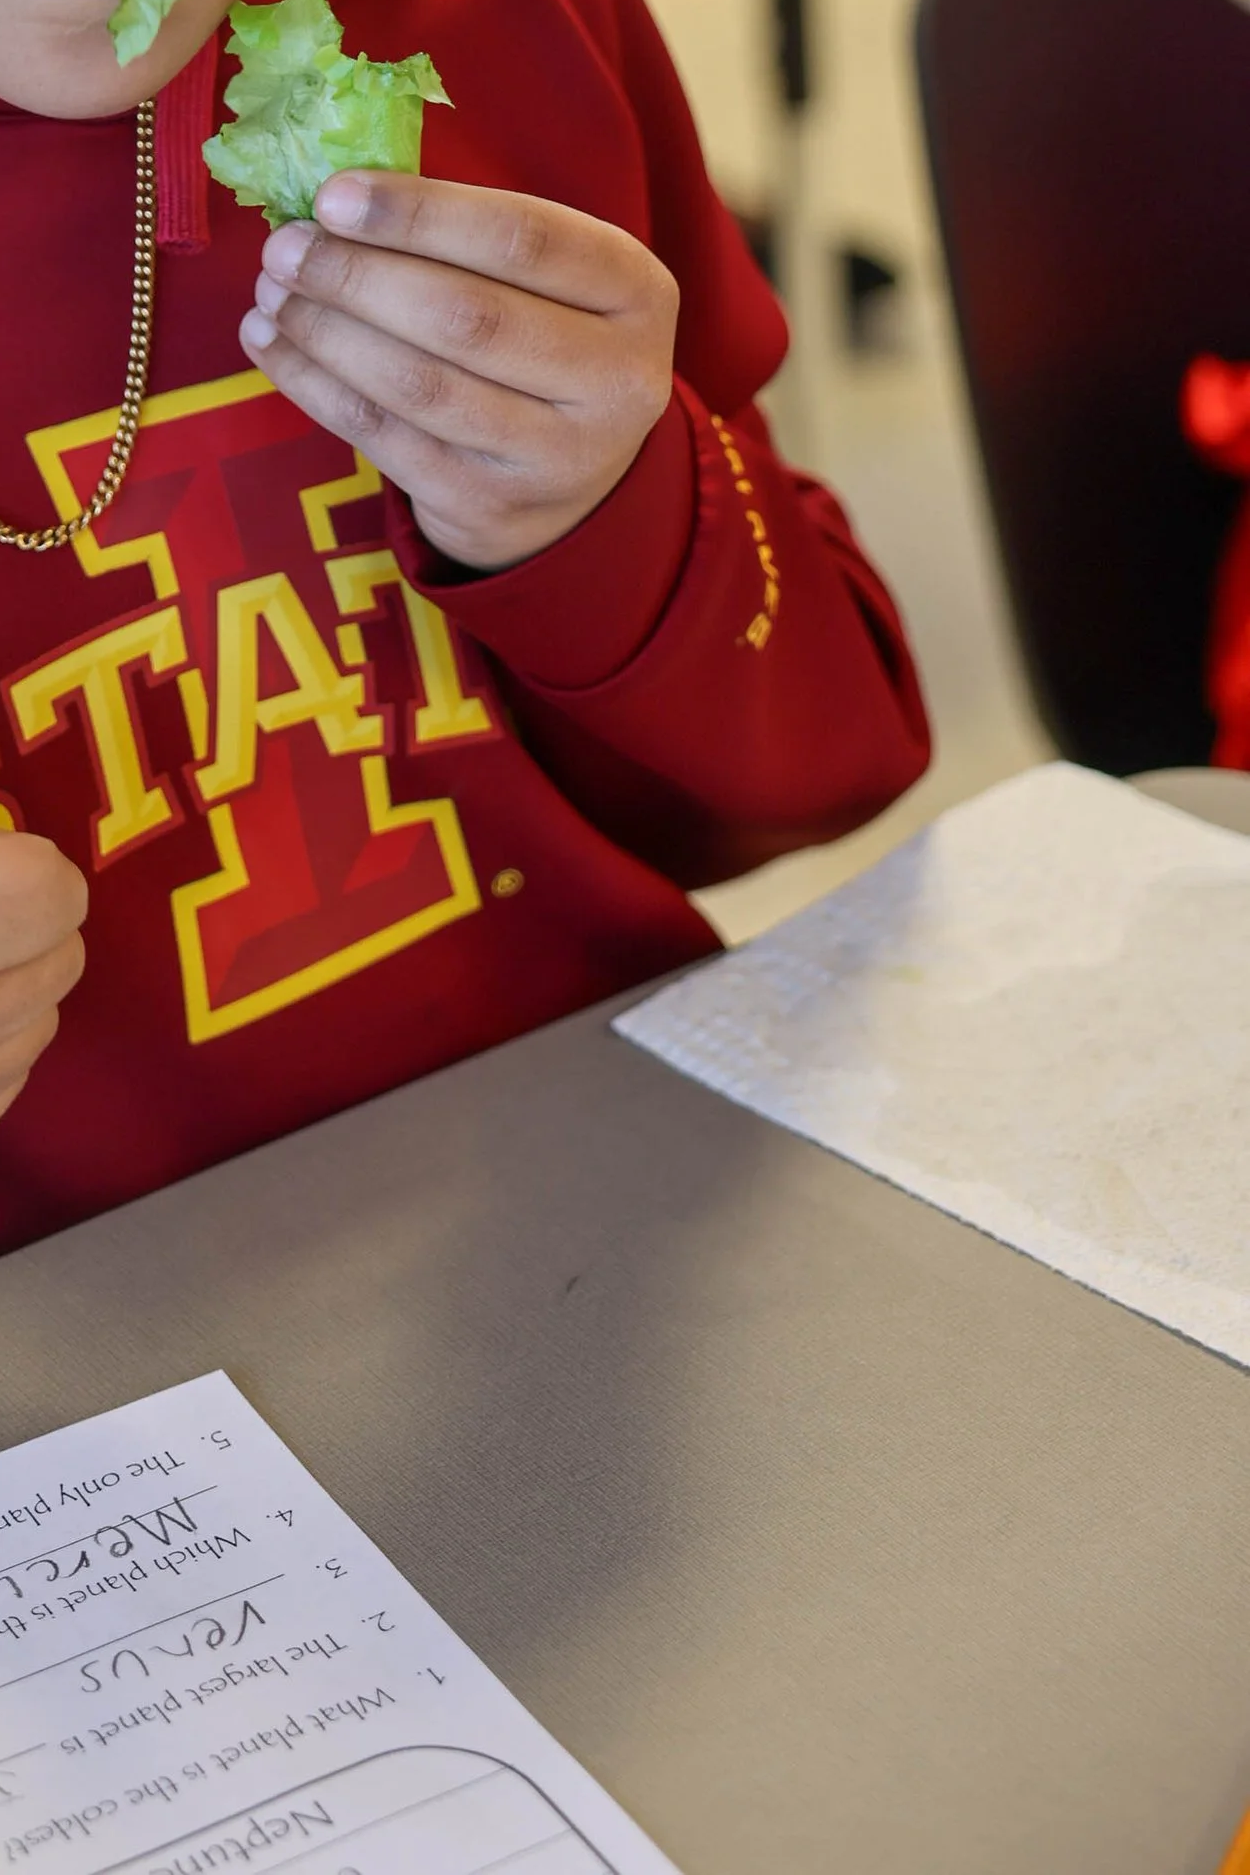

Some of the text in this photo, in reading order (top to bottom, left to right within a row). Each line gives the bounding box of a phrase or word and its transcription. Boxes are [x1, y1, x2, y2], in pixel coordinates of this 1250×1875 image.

[200, 1429, 233, 1451] 5.
[125, 1450, 186, 1478] The
[59, 1471, 121, 1508] only
[265, 1509, 294, 1528] 4.
[152, 1527, 252, 1576] Which
[315, 1557, 349, 1580] 3.
[56, 1559, 149, 1613] planet
[29, 1602, 54, 1621] is
[59, 1610, 396, 1755] 2. The largest planet is
[4, 1667, 446, 1864] 1. What planet is the coldest?
